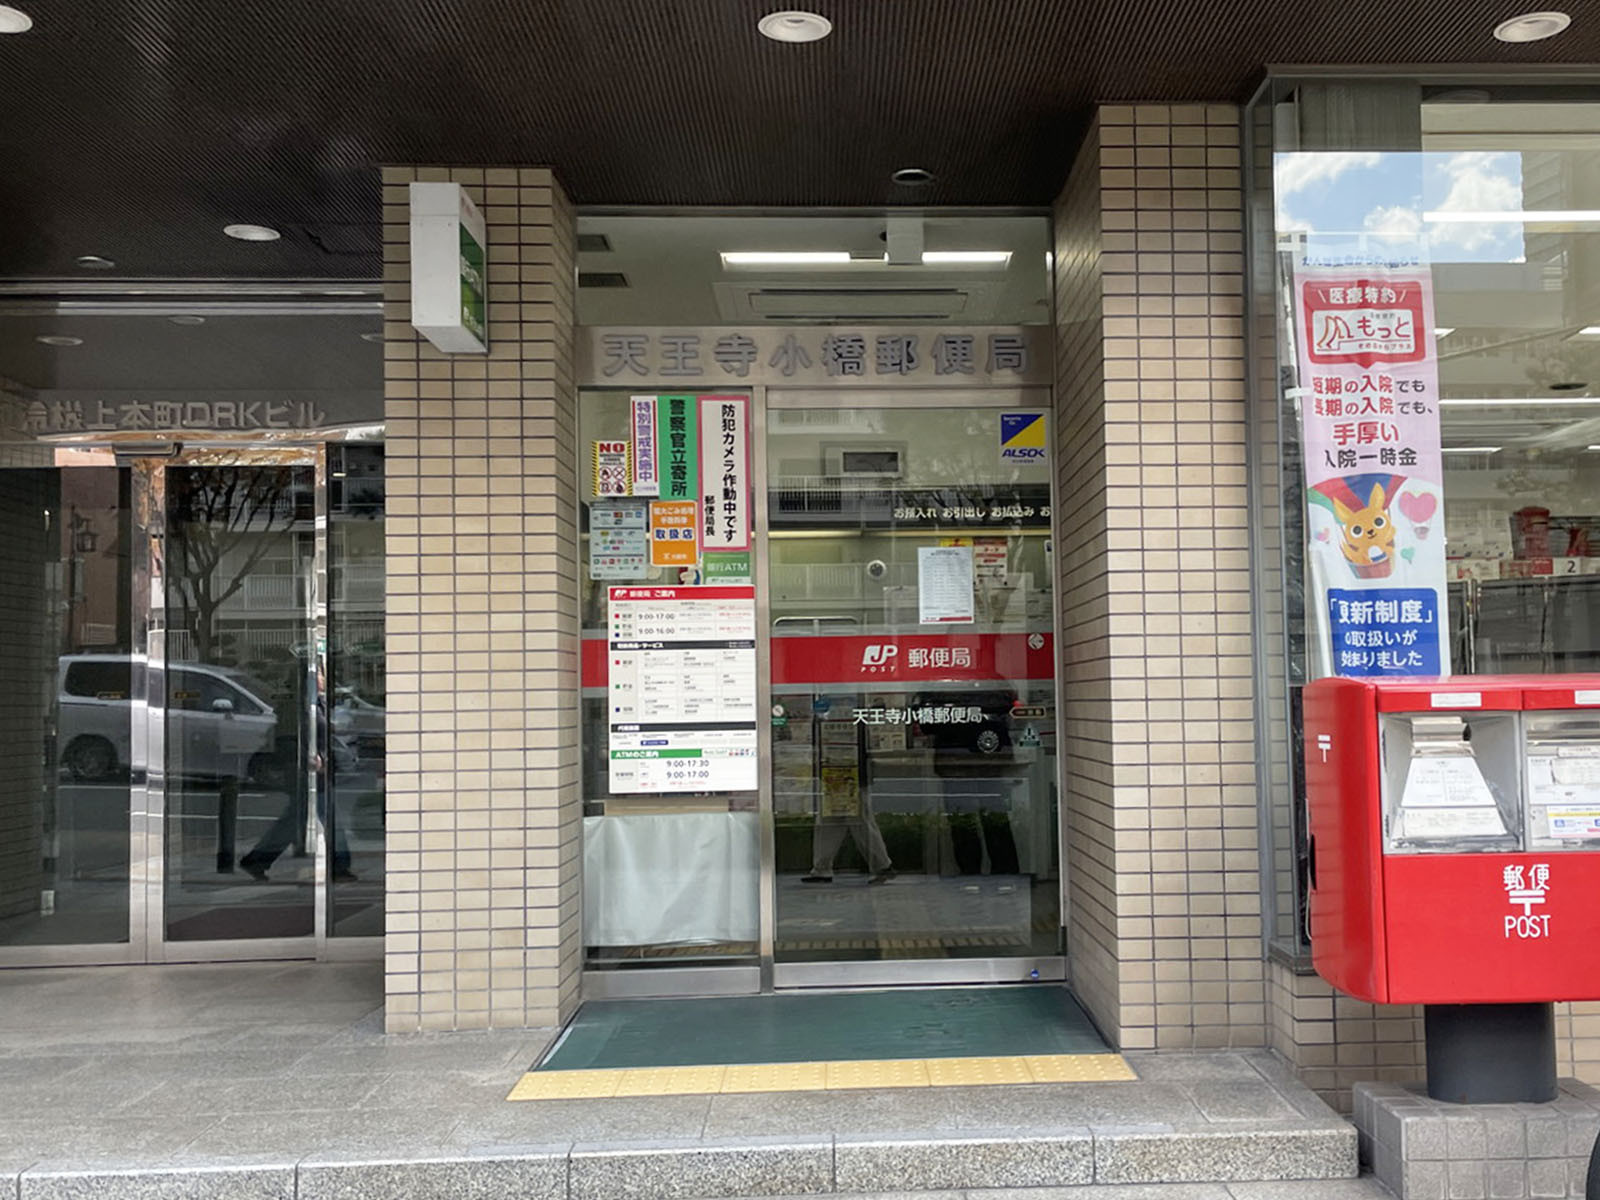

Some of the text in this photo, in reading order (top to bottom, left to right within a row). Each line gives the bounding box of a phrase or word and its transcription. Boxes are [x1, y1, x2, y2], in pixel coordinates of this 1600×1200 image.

[1329, 287, 1396, 304] 医療特約
[1357, 315, 1411, 339] もっと
[602, 333, 1030, 377] 天王寺小橋郵便局
[1333, 421, 1399, 446] 手厚い
[599, 442, 626, 454] NO
[670, 399, 688, 497] 警察官立寄所
[1001, 448, 1046, 458] ALSOK
[1325, 447, 1418, 469] 入院一時金
[721, 404, 737, 542] 防犯カメラ作動中です
[704, 495, 716, 537] 郵便局長
[943, 507, 985, 519] お引出し
[991, 507, 1034, 518] お払込み
[655, 529, 693, 540] 取扱店
[860, 665, 896, 673] POST
[908, 647, 971, 669] 郵便局
[852, 706, 983, 726] 天王寺小橋郵便局
[1503, 864, 1551, 891] 郵便
[1504, 914, 1552, 938] POST
